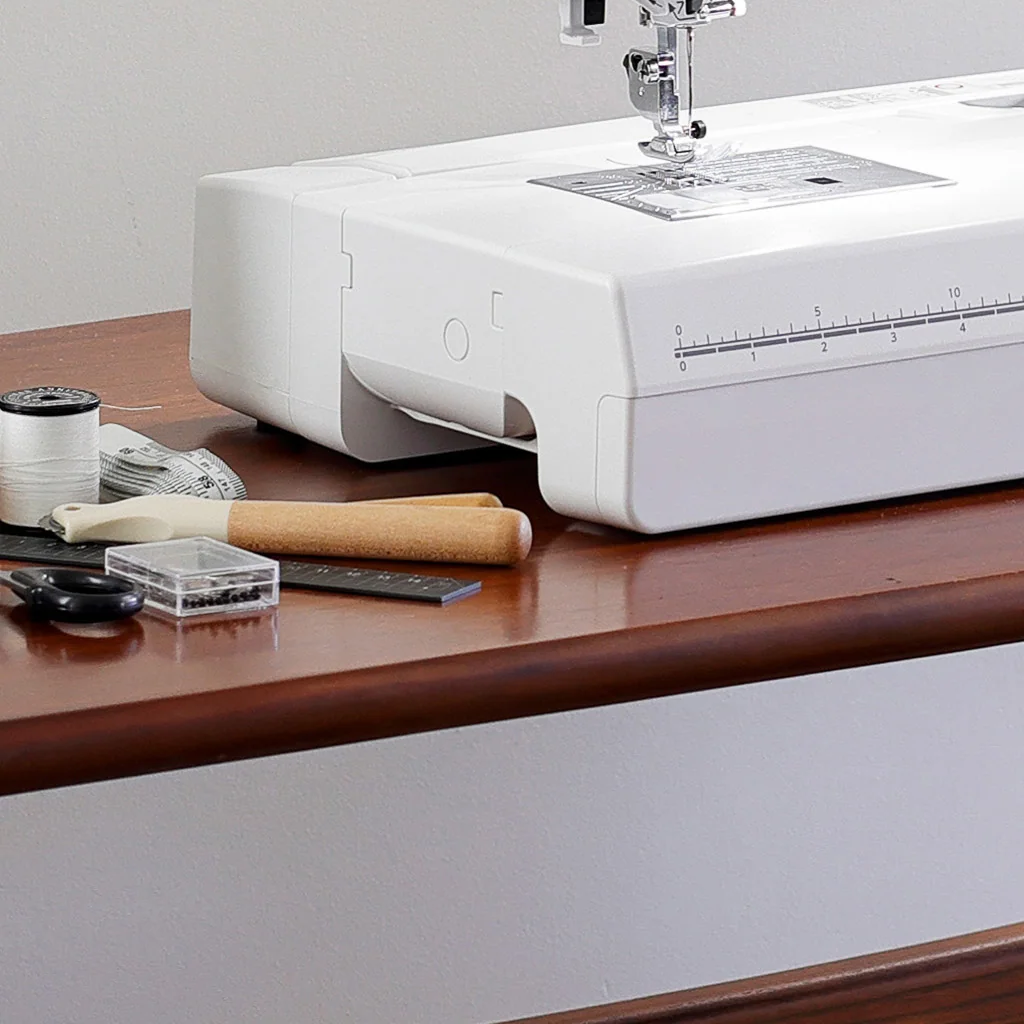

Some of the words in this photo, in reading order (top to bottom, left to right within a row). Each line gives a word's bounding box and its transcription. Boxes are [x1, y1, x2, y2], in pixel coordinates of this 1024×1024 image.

[675, 324, 684, 336] 0
[814, 306, 822, 317] 5
[948, 286, 961, 299] 10
[679, 361, 687, 373] 0
[750, 351, 756, 362] 1
[820, 342, 828, 353] 2
[890, 332, 898, 343] 3
[959, 322, 967, 333] 4
